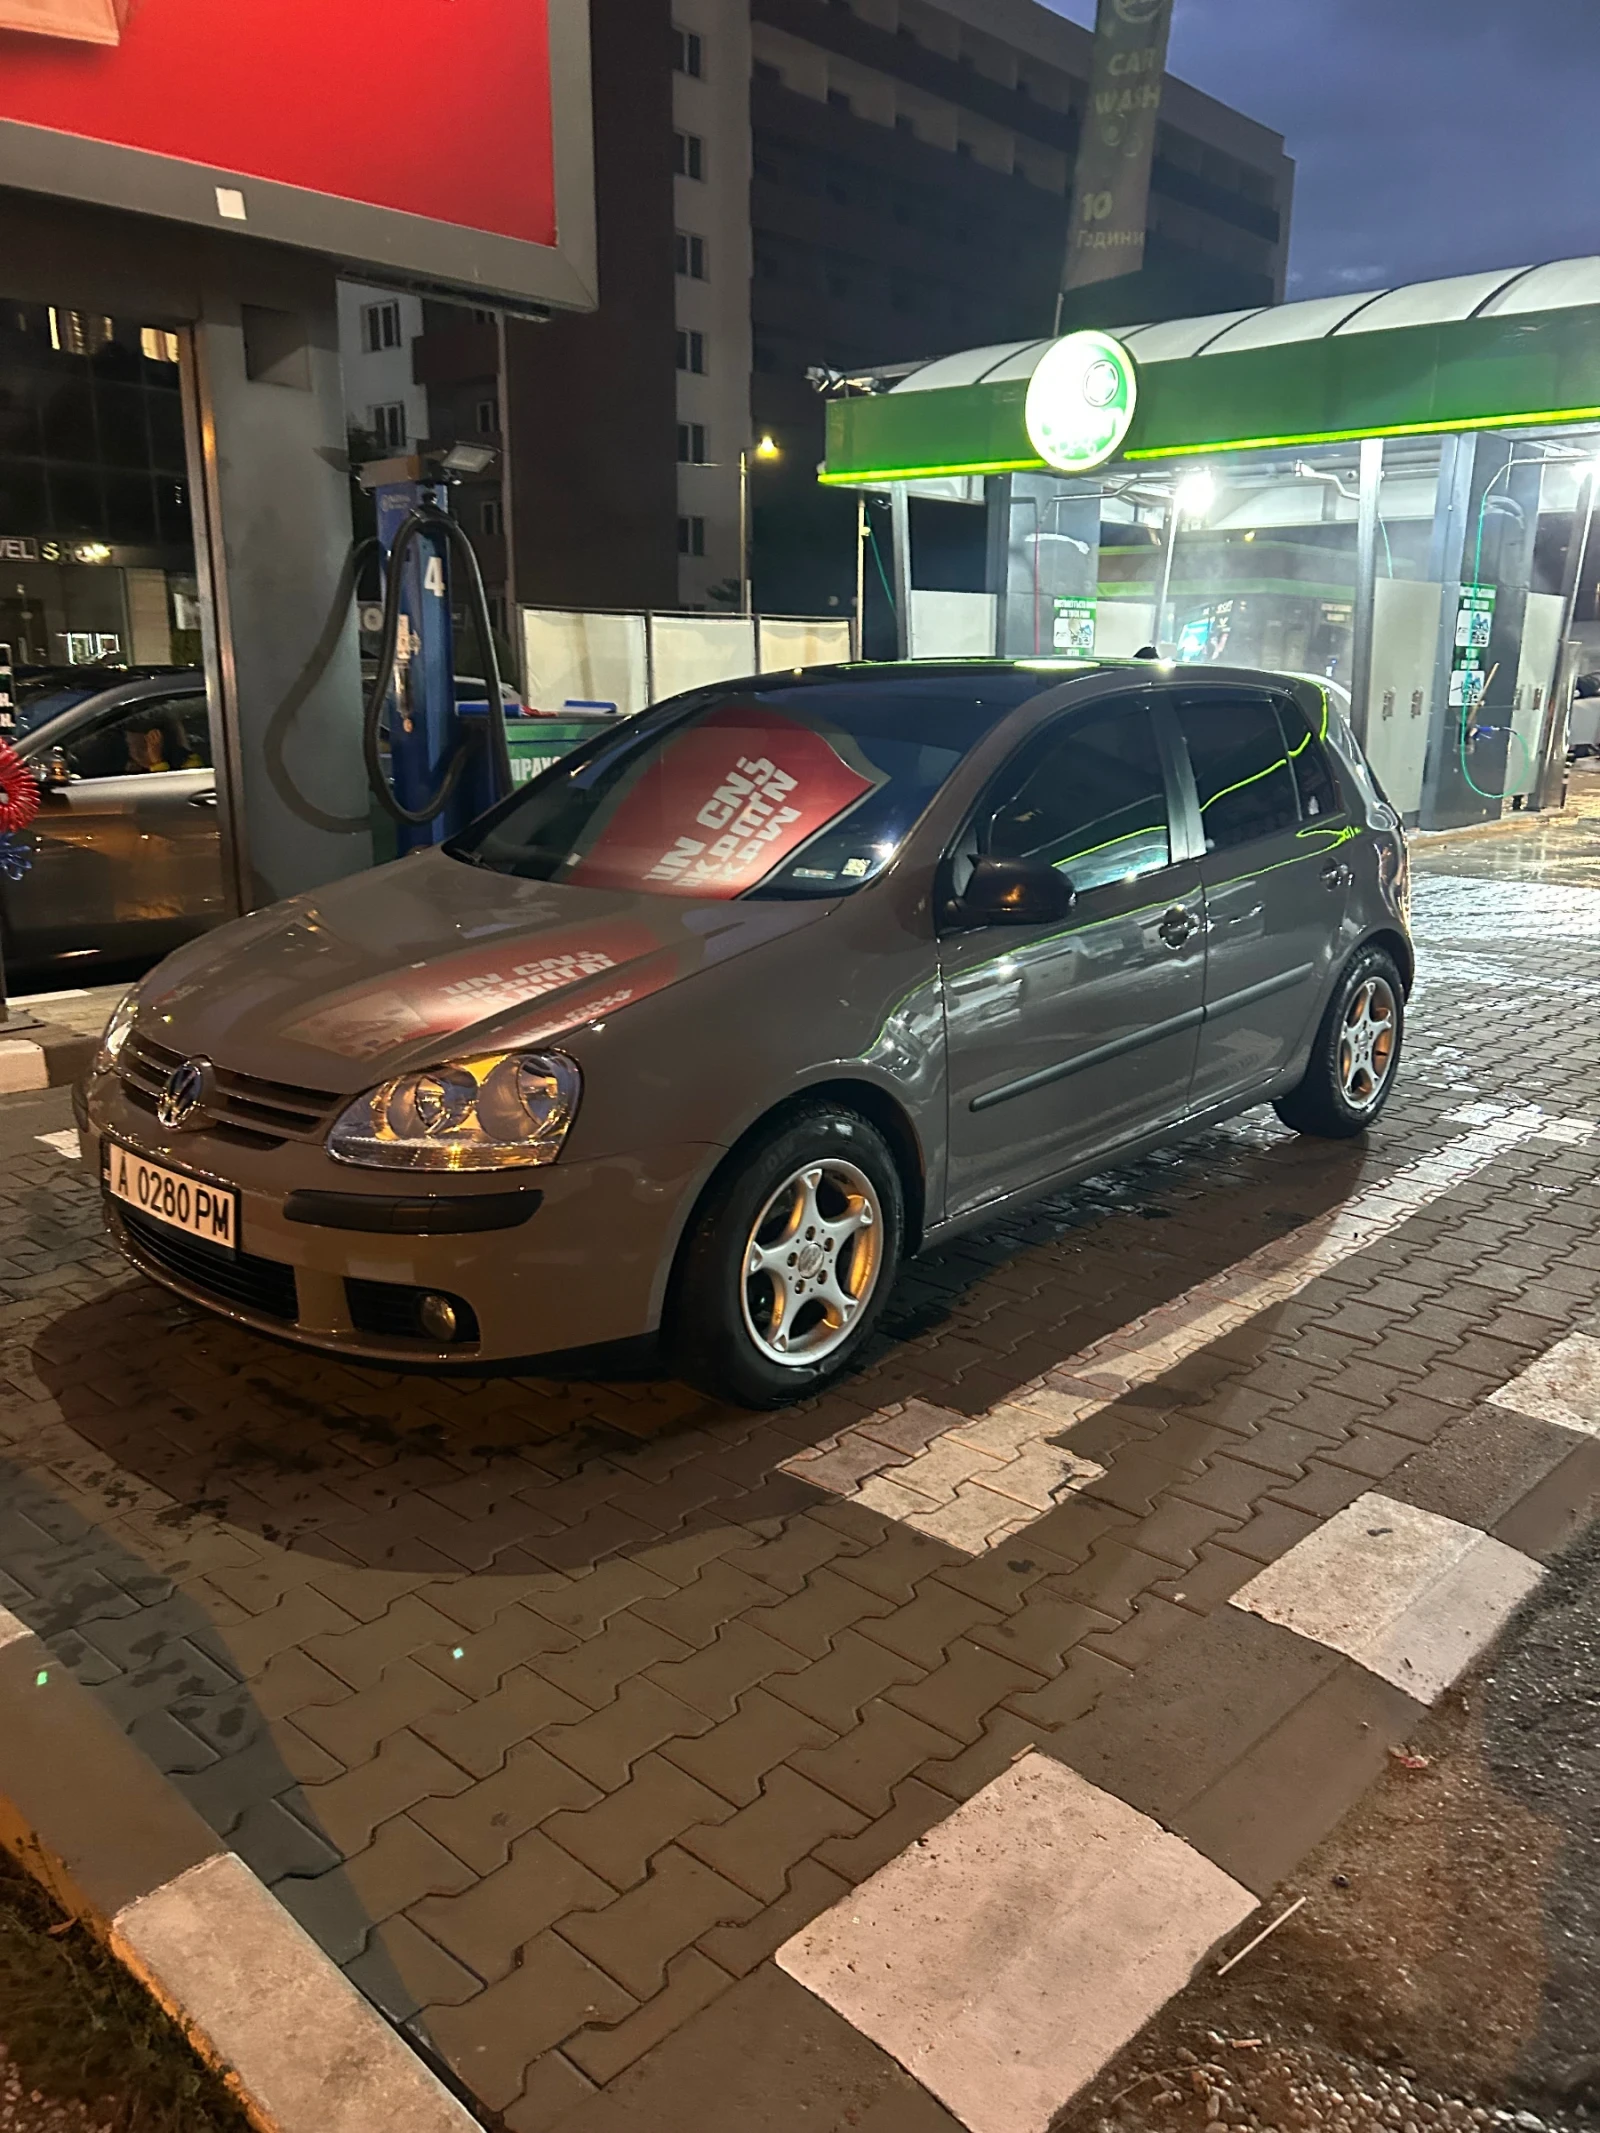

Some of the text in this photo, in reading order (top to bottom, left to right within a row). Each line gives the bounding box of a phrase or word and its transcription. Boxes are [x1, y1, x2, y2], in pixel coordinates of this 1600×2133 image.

[1095, 85, 1162, 115] WASH
[1082, 190, 1113, 222] 10
[424, 556, 446, 598] 4
